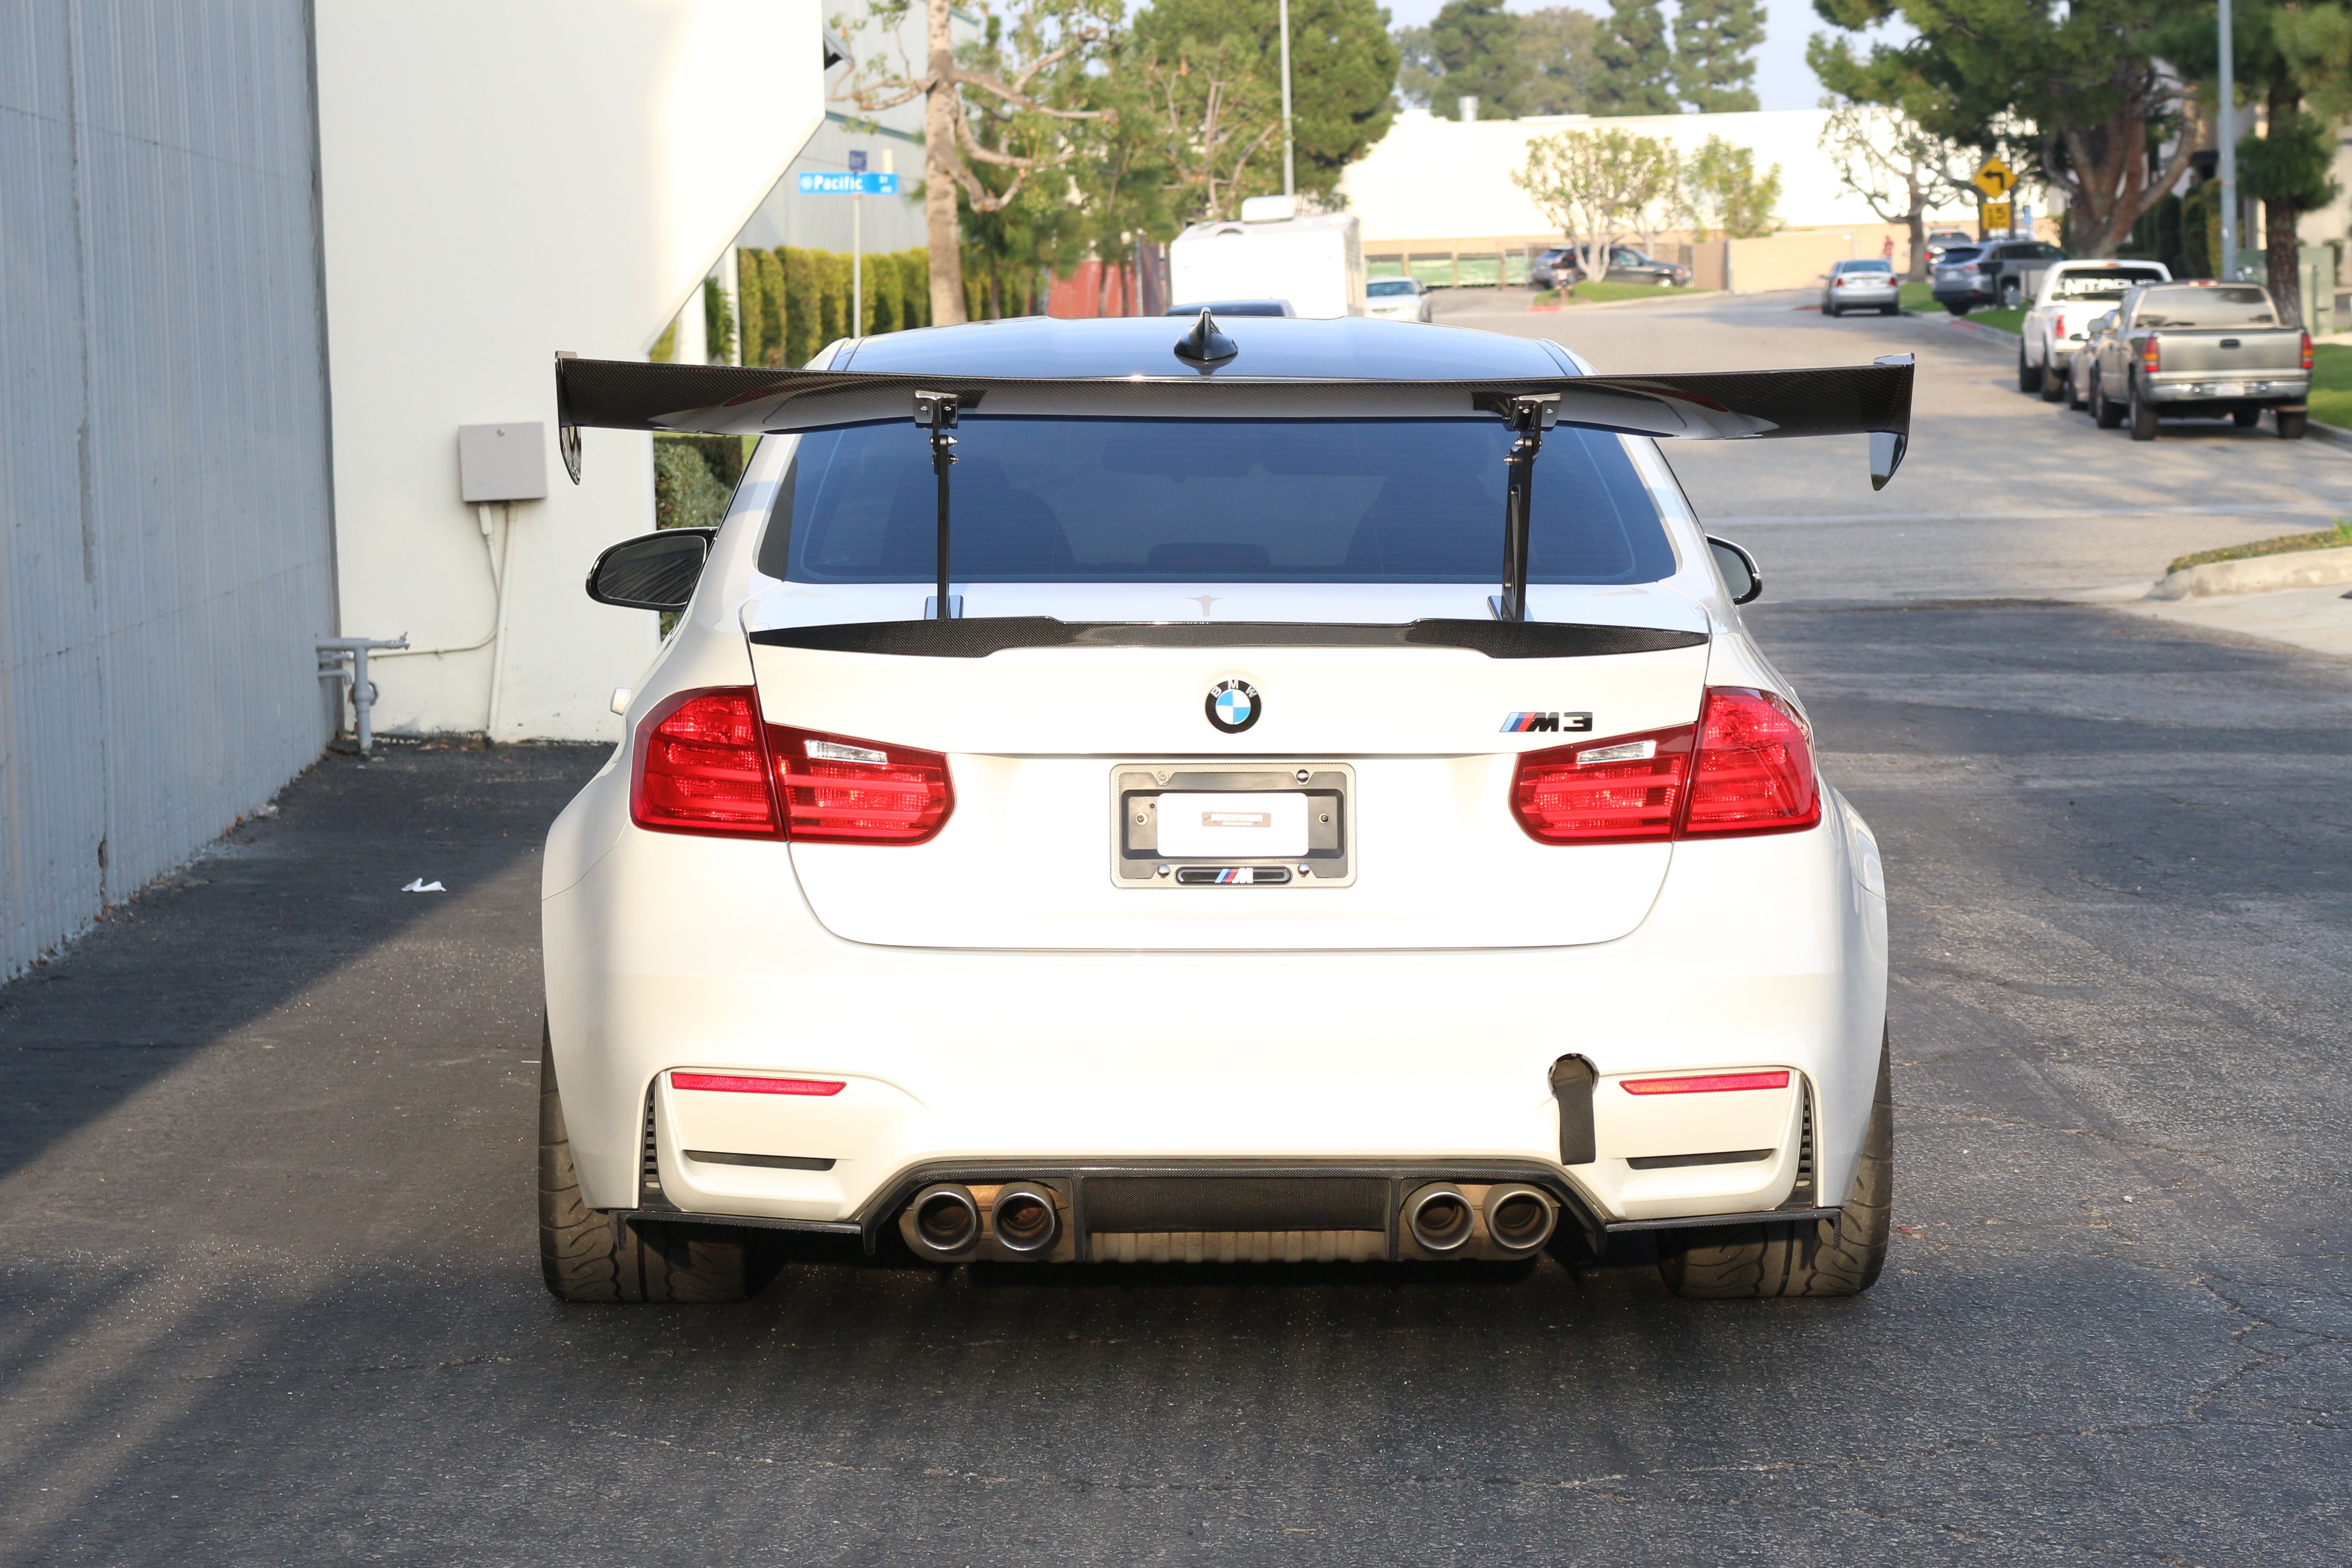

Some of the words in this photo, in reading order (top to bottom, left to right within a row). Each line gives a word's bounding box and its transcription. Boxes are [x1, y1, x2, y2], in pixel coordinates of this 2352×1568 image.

[813, 175, 863, 190] Pacific
[1988, 207, 2006, 220] 15
[2065, 278, 2156, 295] NITRO
[1210, 680, 1257, 699] BMW
[1525, 712, 1593, 732] M3
